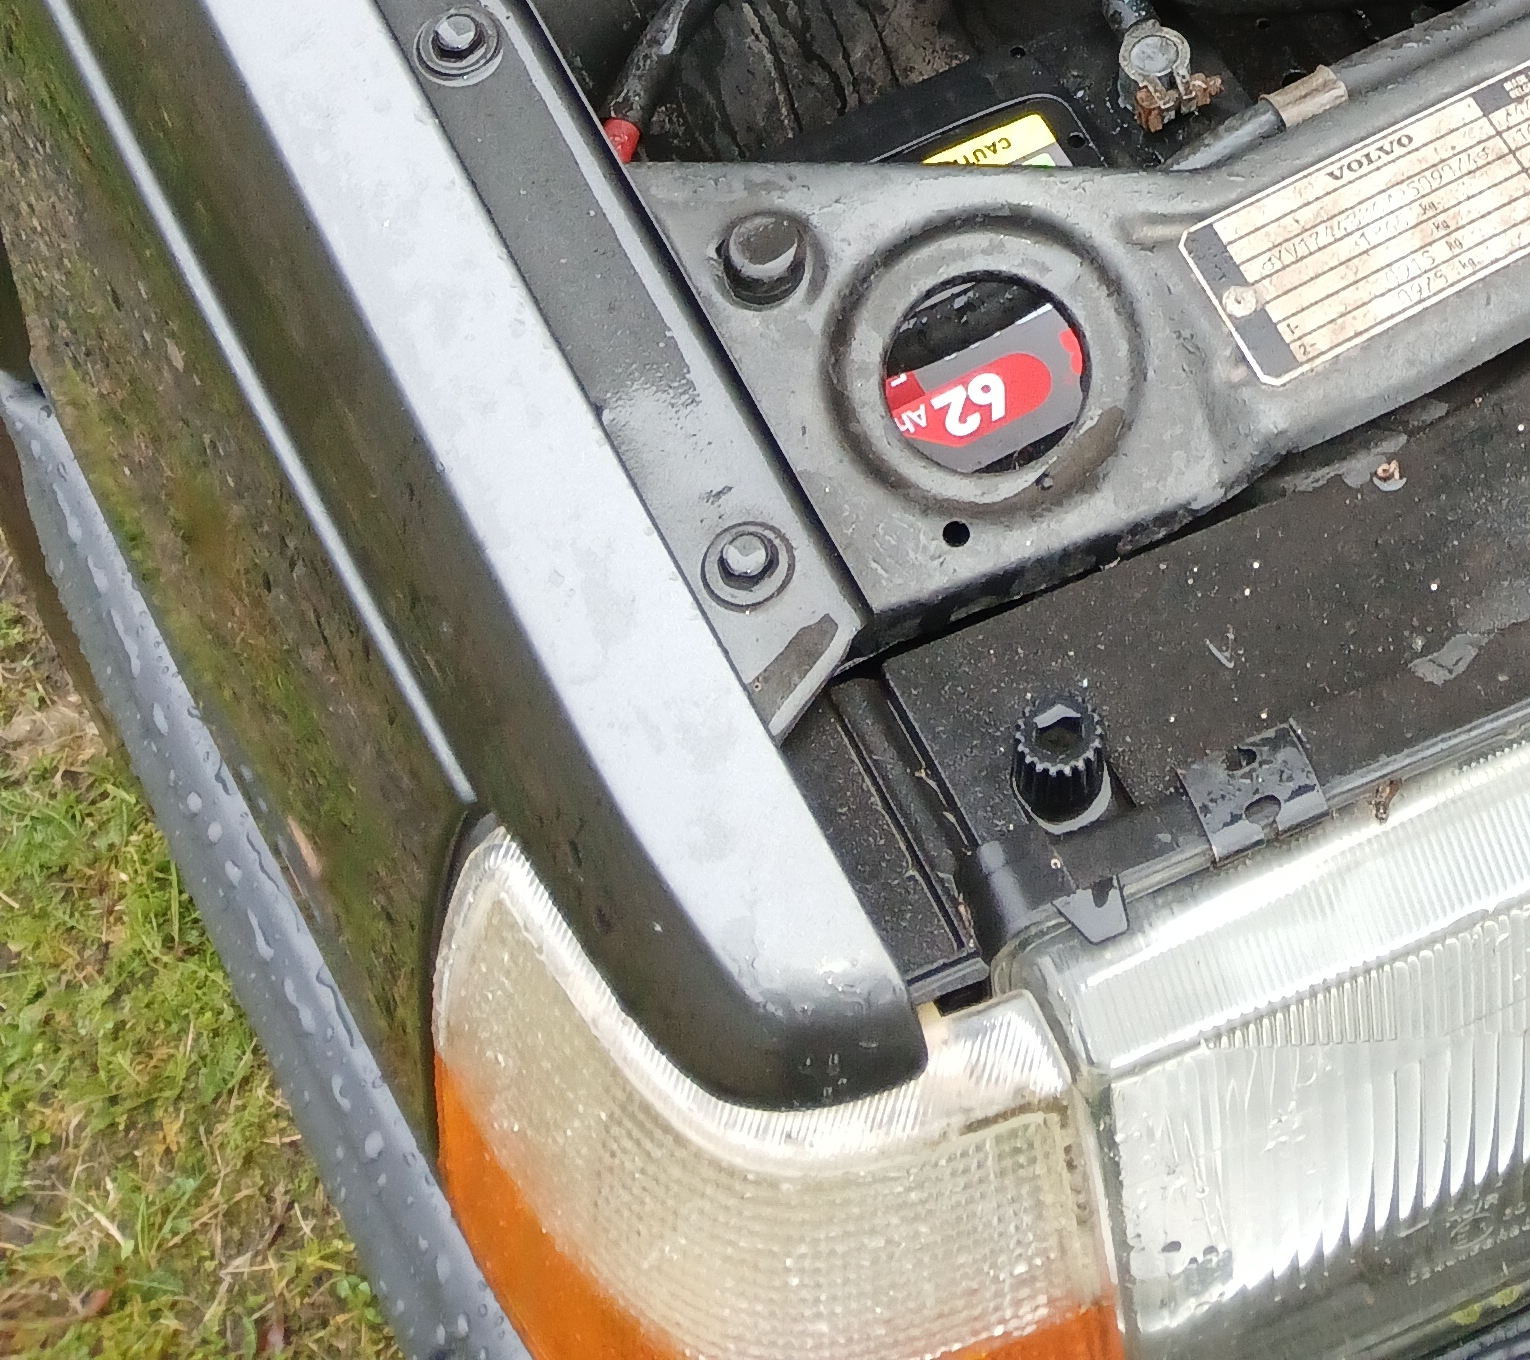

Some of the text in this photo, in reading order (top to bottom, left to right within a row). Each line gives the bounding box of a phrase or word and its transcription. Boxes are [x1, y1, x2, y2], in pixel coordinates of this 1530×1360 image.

[955, 137, 1012, 164] CAUT
[1324, 133, 1414, 181] VOLVO
[894, 372, 1006, 437] 62 Ah
